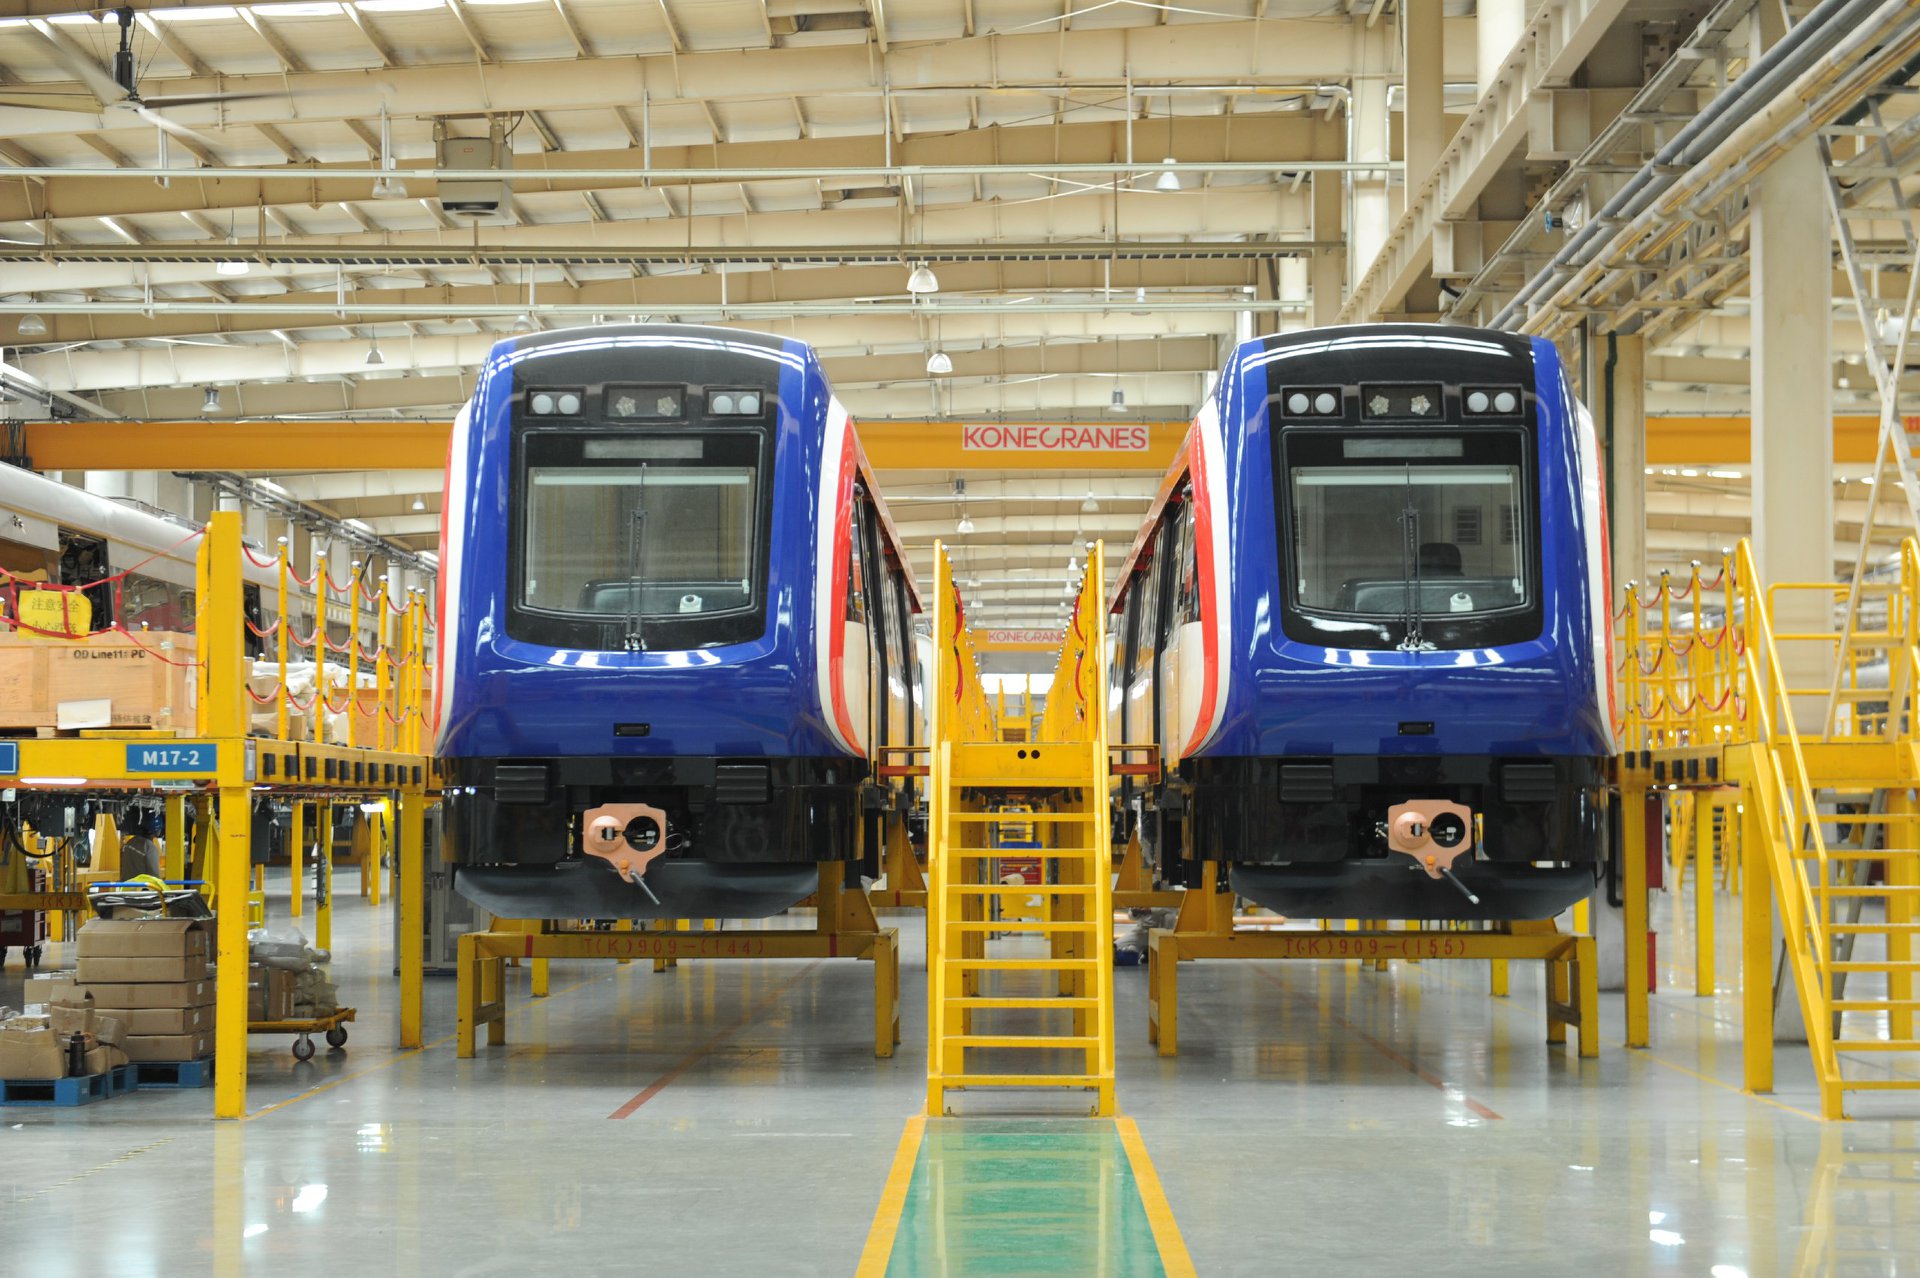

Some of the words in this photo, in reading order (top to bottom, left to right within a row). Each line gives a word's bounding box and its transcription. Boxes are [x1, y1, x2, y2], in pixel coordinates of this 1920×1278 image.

[964, 427, 1146, 449] KONECRANES
[988, 631, 1062, 642] KONECRAN
[143, 750, 200, 766] M17-2
